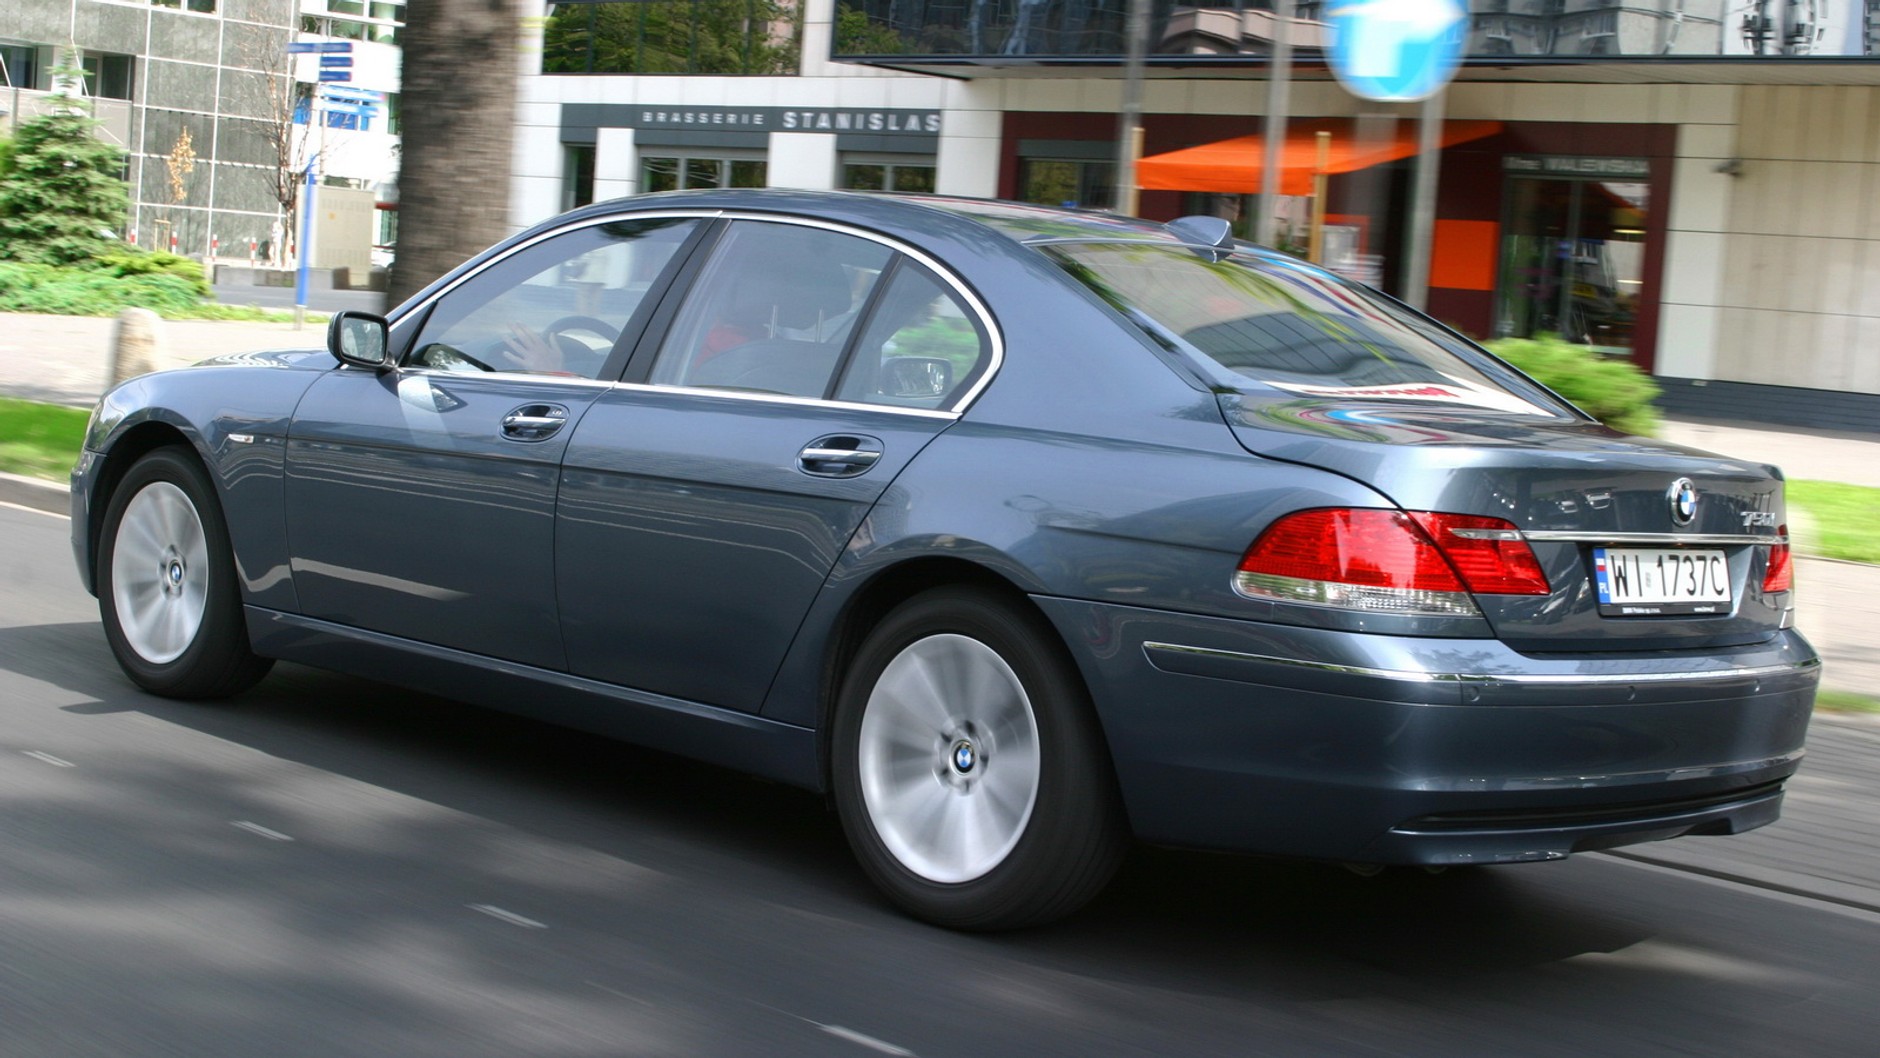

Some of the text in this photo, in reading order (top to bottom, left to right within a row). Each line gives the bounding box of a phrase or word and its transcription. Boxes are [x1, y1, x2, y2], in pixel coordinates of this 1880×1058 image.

[642, 111, 941, 132] BRASSERIE STANISLAS
[1610, 554, 1725, 597] WI 1737C
[1599, 581, 1609, 594] PL
